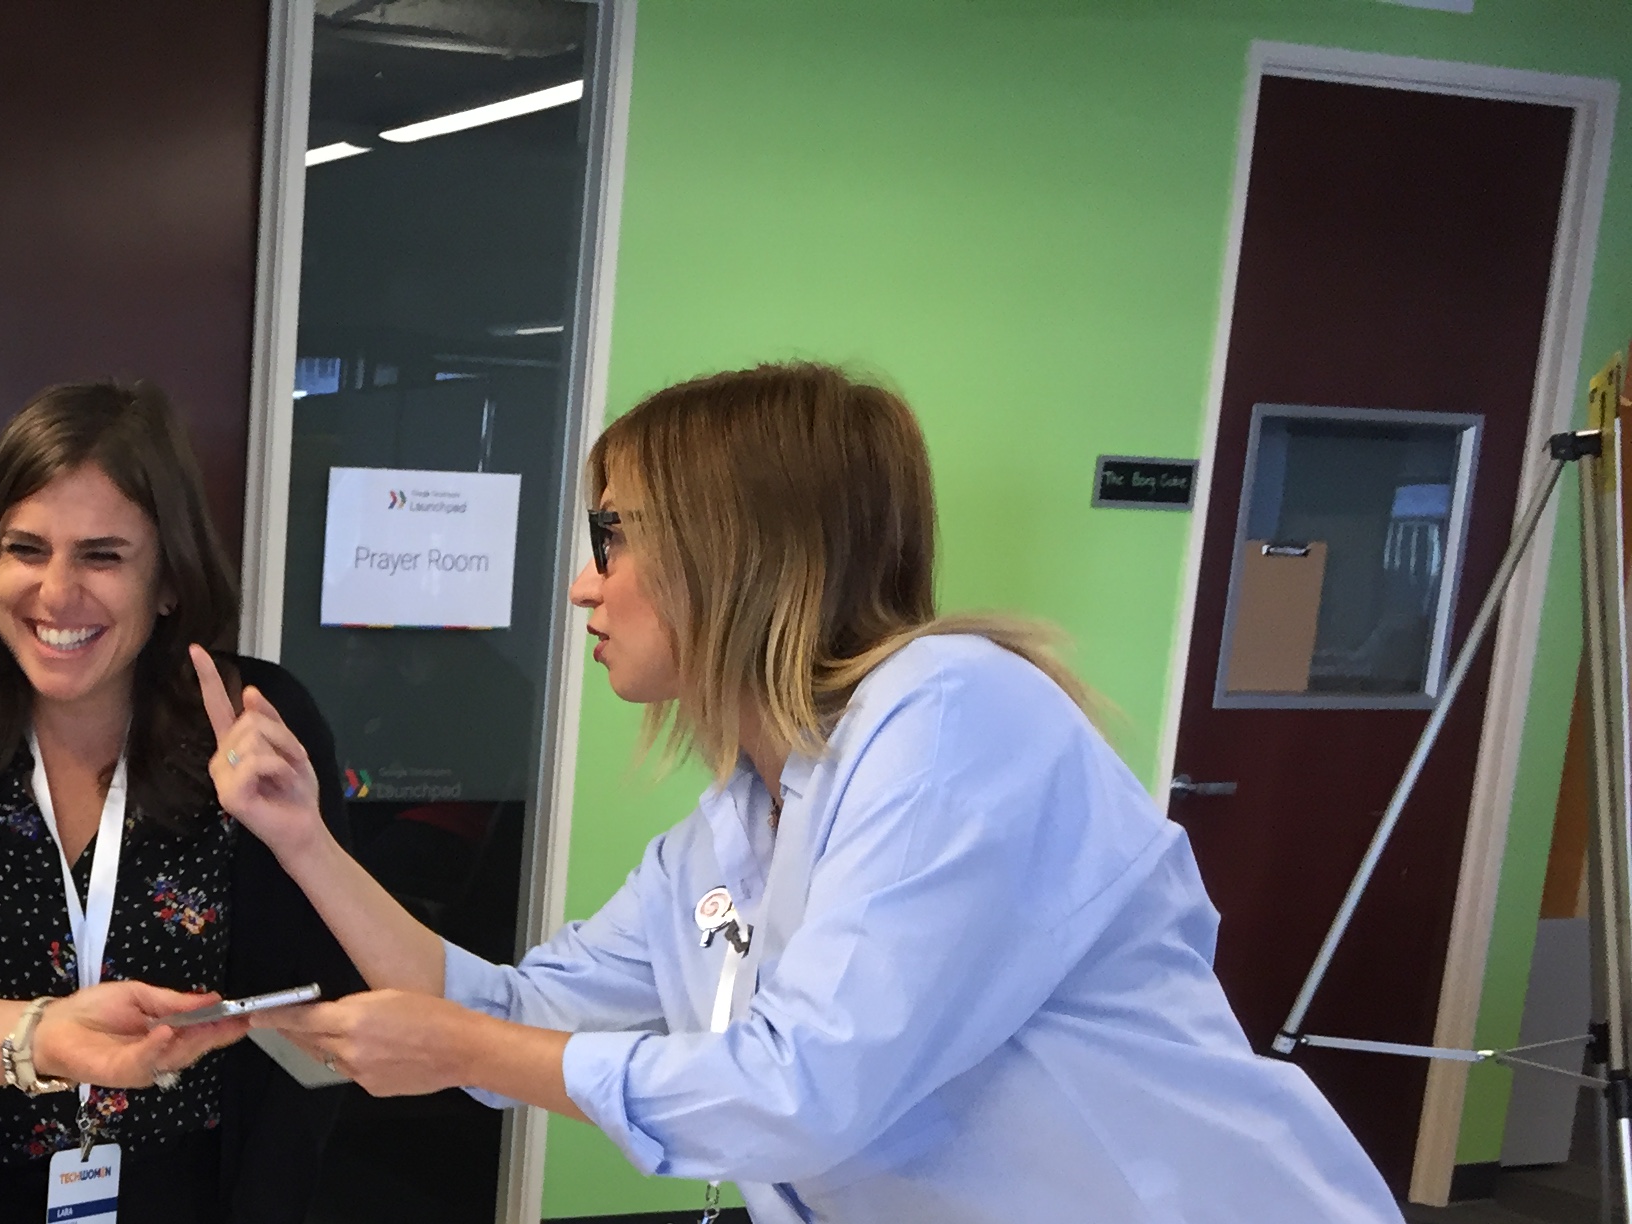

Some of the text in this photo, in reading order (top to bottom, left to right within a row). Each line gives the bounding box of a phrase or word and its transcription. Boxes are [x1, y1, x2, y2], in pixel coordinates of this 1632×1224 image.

[1102, 470, 1125, 486] The
[409, 501, 467, 514] Launchpad
[354, 545, 490, 577] Prayer Room
[376, 781, 463, 802] Launchpad
[56, 1207, 74, 1218] LARA
